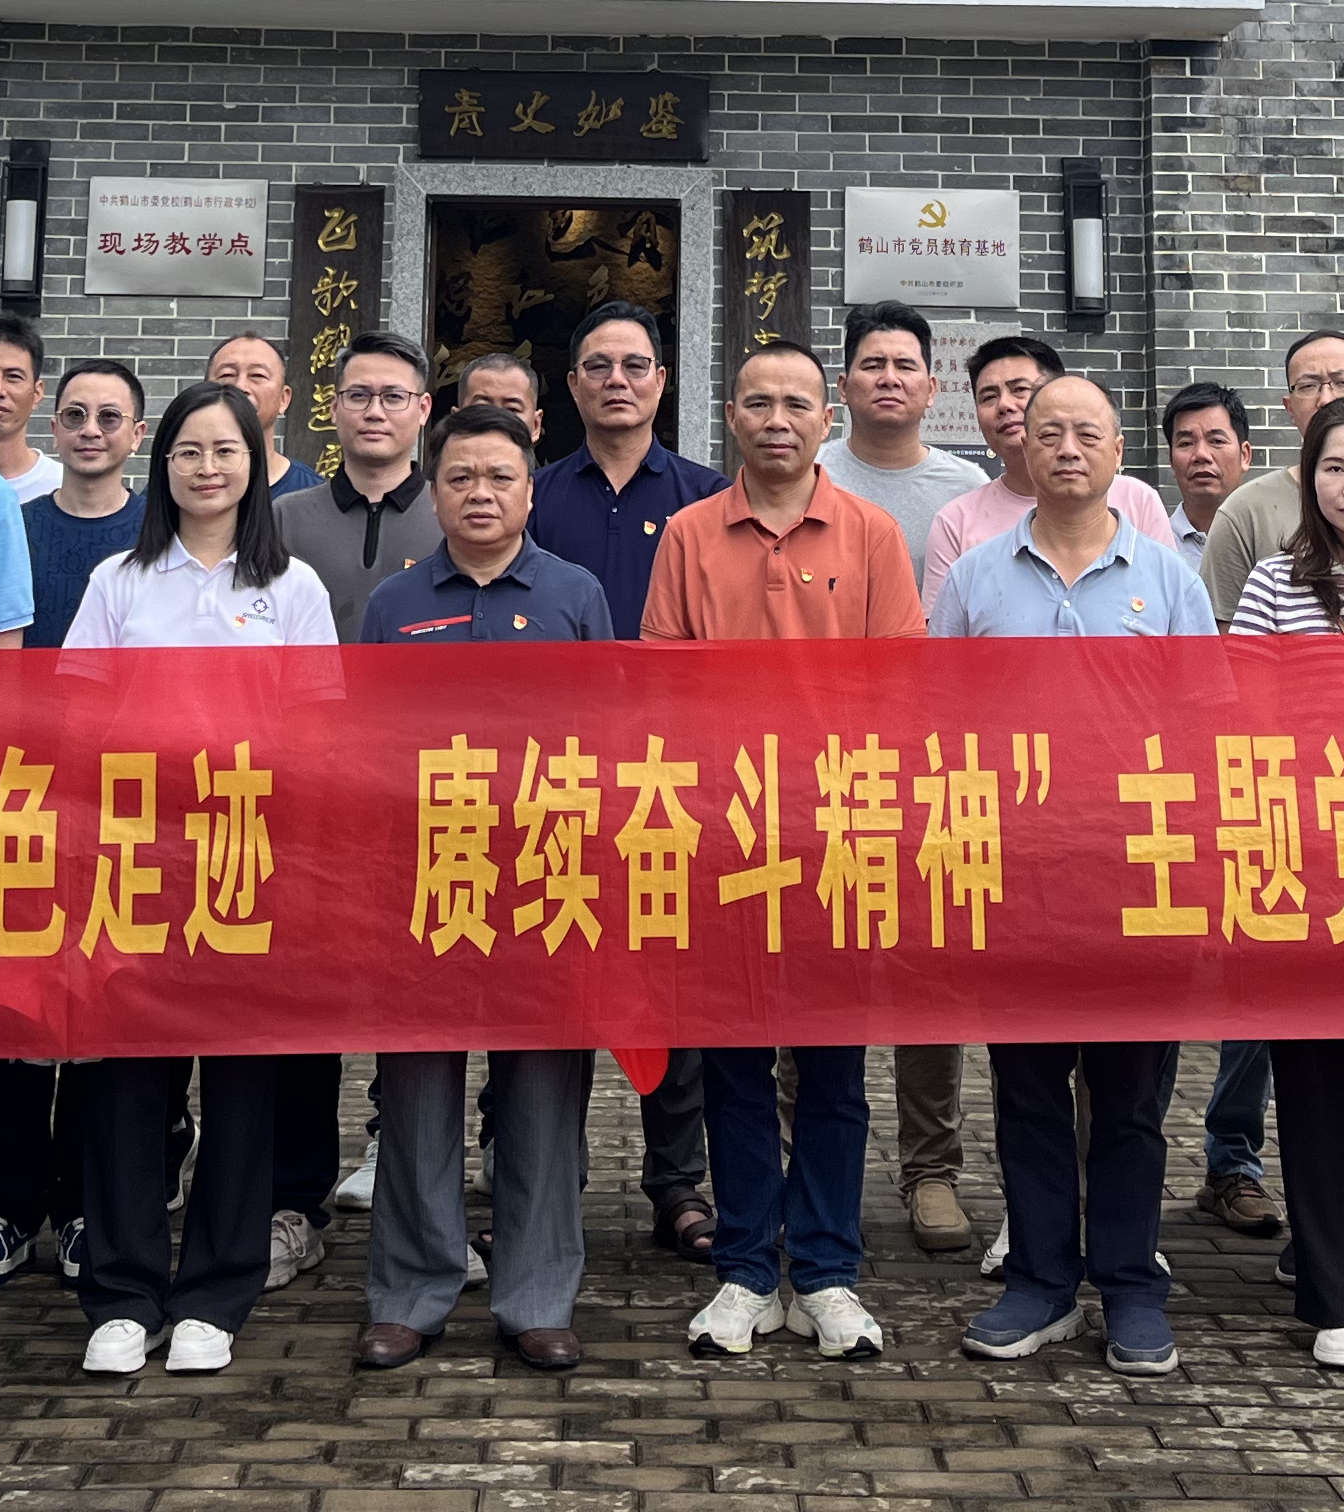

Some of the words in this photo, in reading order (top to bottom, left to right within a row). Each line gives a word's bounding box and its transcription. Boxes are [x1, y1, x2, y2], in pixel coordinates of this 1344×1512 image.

[97, 232, 254, 257] 现场教学点
[858, 236, 1007, 257] 鹤山市党员教育基地
